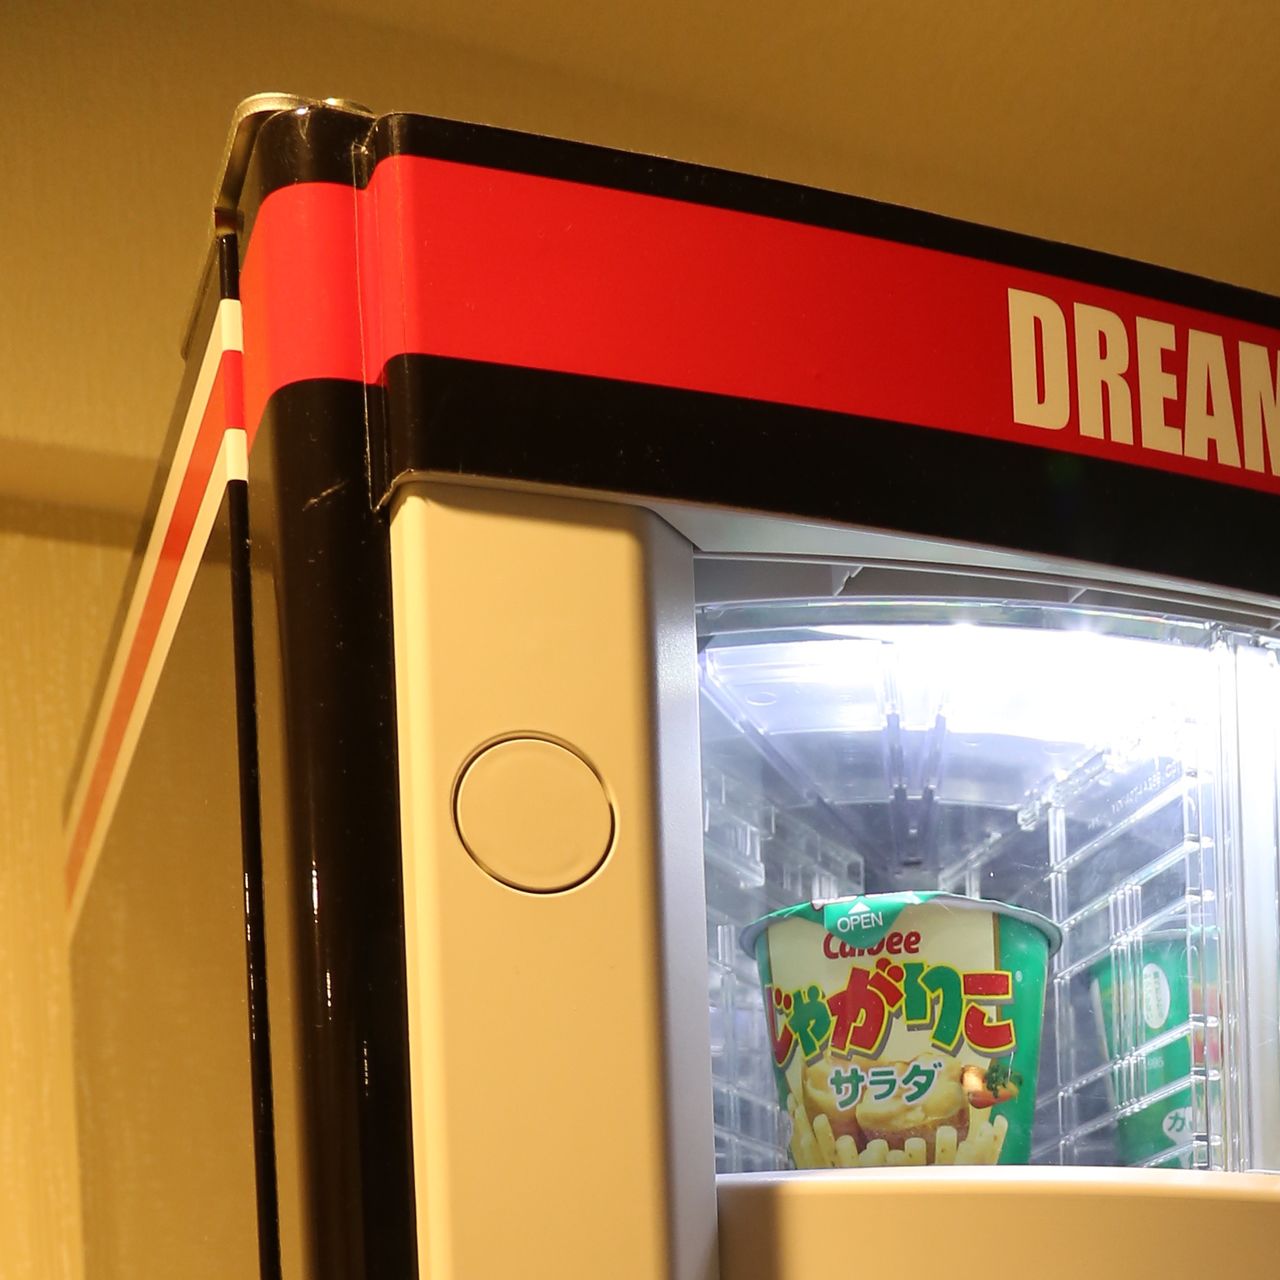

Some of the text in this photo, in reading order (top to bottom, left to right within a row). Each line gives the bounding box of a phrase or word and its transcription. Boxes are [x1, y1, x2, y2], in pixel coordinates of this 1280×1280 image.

[837, 911, 883, 933] OPEN
[766, 957, 1016, 1067] じゃがりこ
[829, 1061, 943, 1110] サラダ
